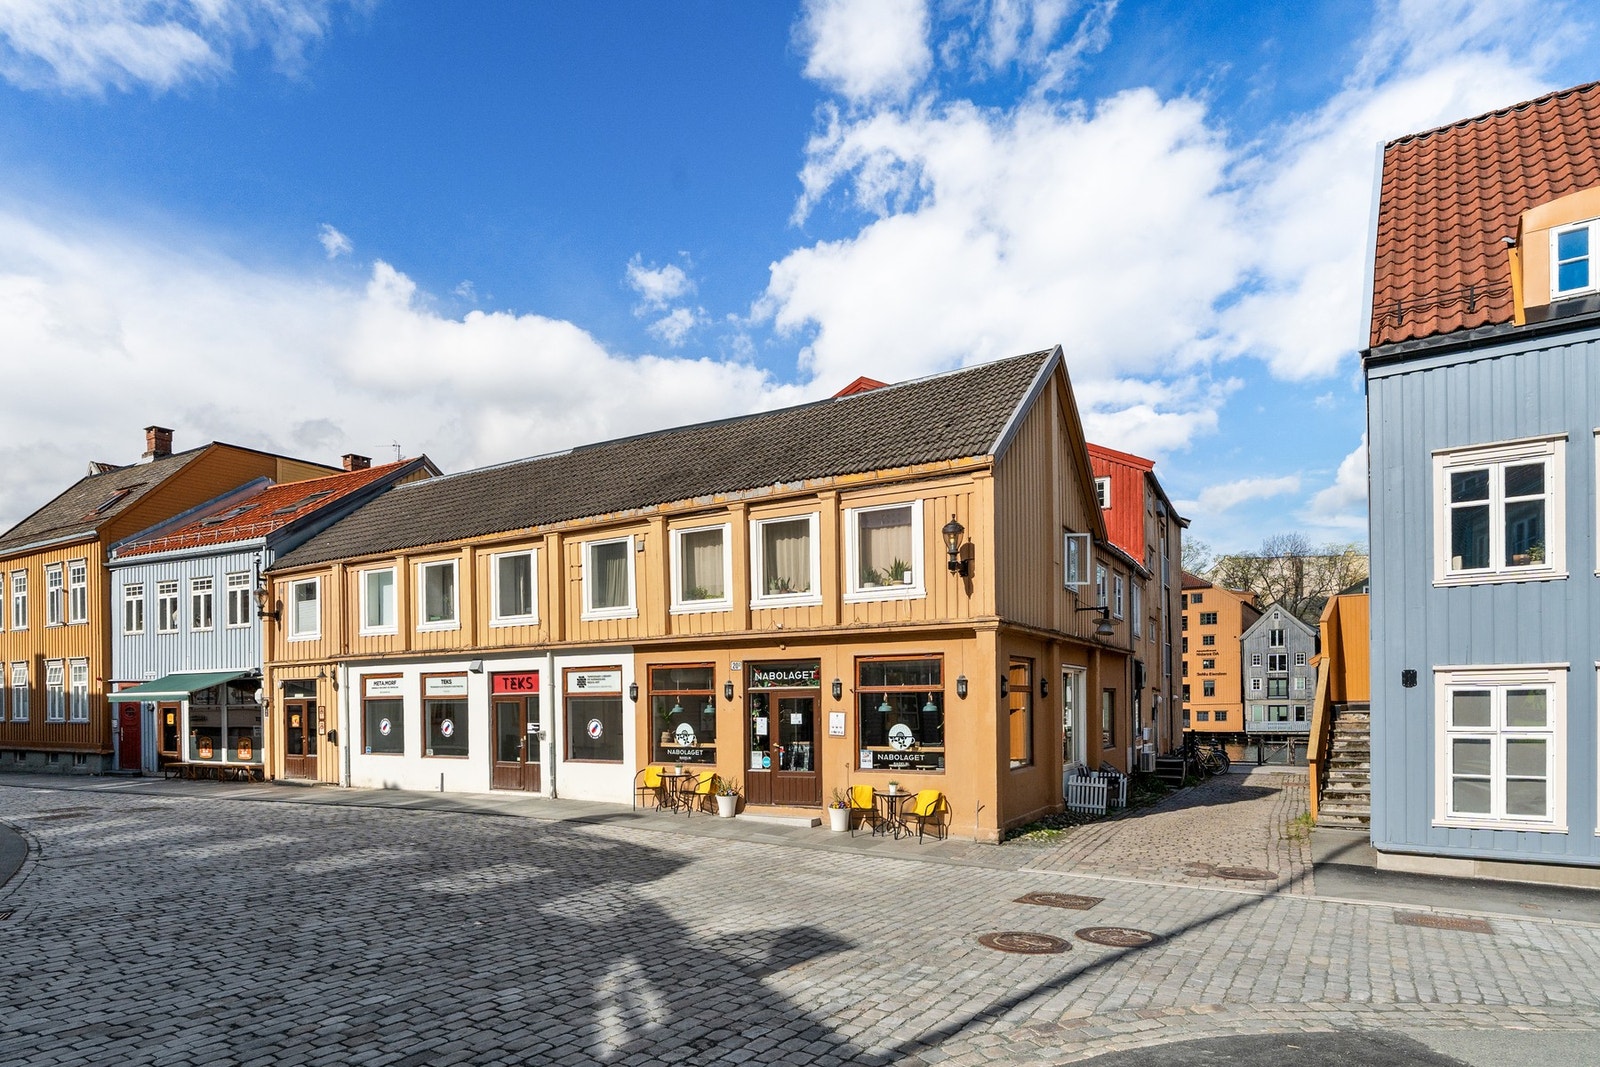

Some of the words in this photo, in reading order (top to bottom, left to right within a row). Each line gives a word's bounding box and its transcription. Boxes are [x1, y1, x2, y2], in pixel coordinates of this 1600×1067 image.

[754, 671, 816, 680] NABOLAGET
[502, 676, 534, 690] TEKS
[877, 753, 925, 761] NABOLAGET
